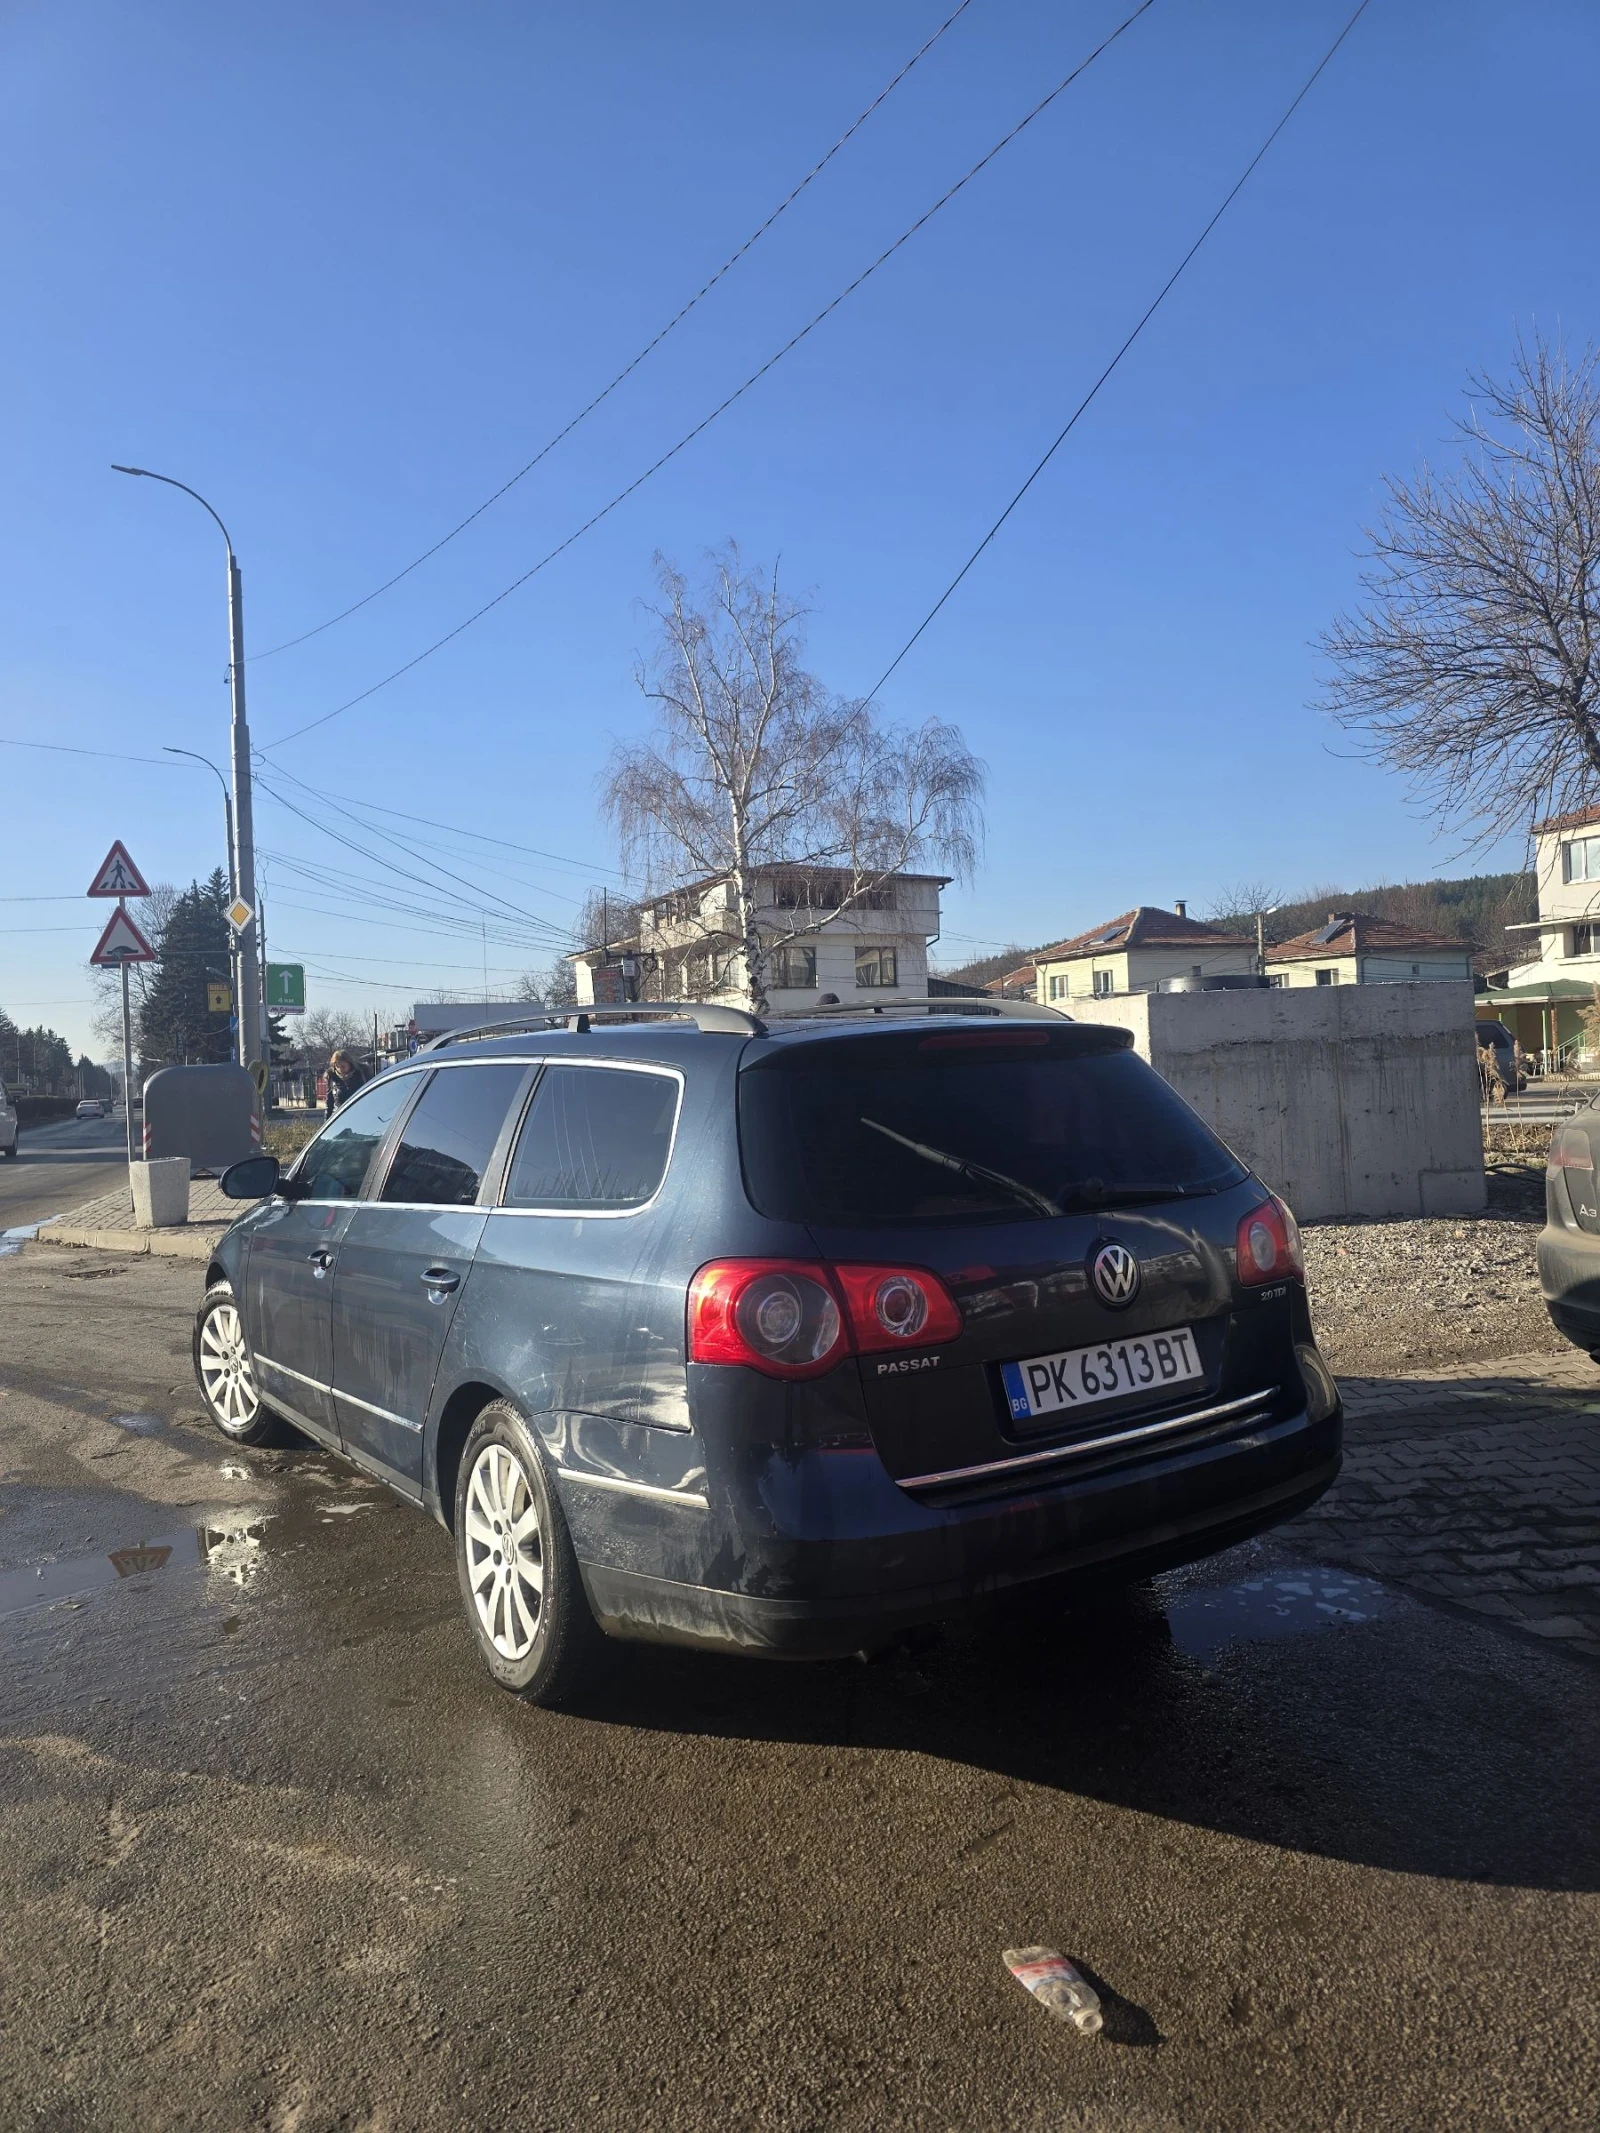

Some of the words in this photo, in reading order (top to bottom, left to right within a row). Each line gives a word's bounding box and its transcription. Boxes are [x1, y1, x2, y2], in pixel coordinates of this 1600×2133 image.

[1580, 1204, 1597, 1217] A3
[877, 1356, 940, 1375] PASSAT
[1011, 1397, 1028, 1412] BG
